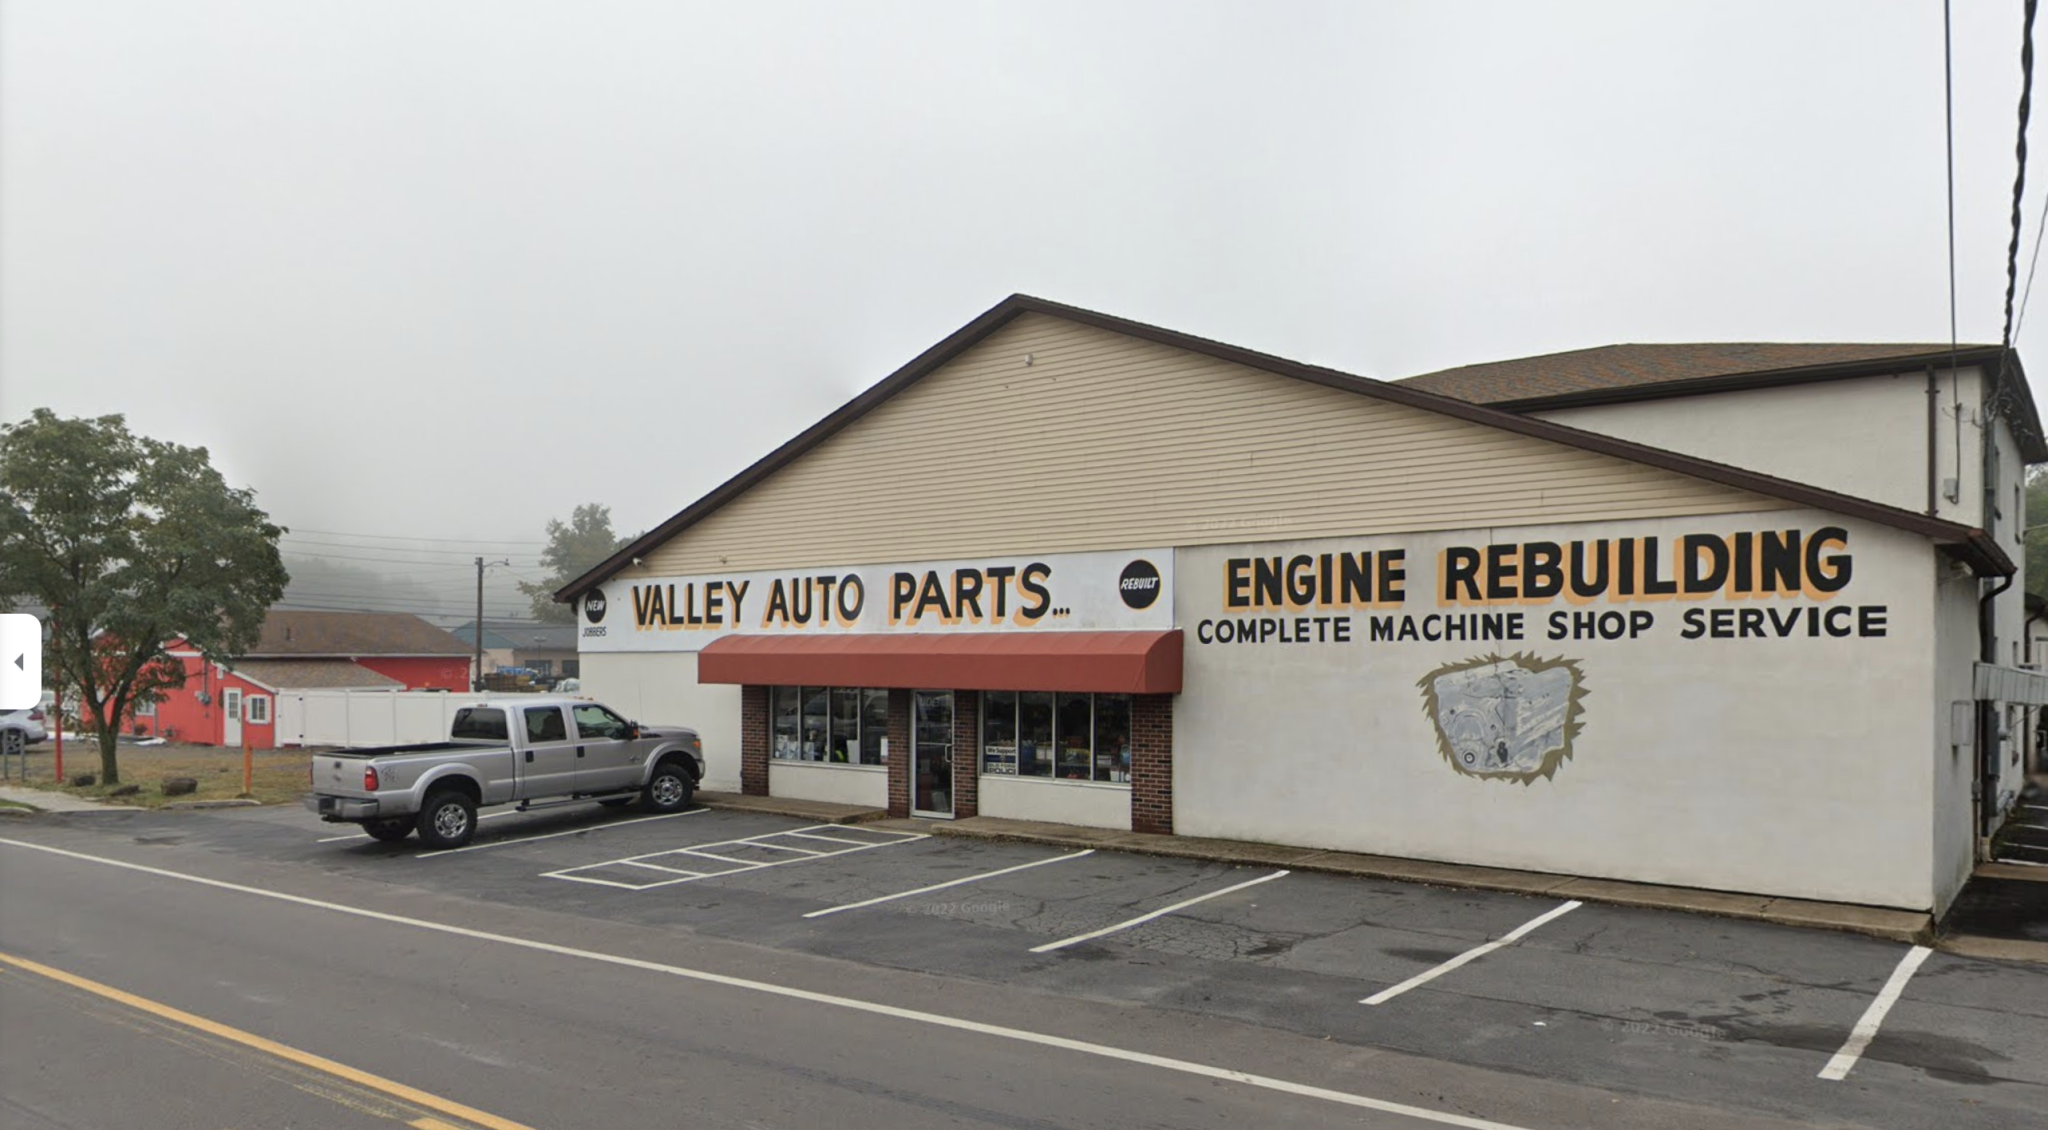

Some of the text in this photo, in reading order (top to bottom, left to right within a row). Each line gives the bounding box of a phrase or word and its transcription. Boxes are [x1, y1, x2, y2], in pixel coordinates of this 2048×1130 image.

[1223, 526, 1852, 612] ENGINE REBUILDING
[1120, 576, 1159, 590] REBUILT
[586, 600, 606, 611] NEW
[631, 562, 1070, 631] VALLEY AUTO PARTS...
[583, 627, 606, 637] JOBBERS
[1197, 606, 1887, 644] COMPLETE MACHINE SHOP SERVICE
